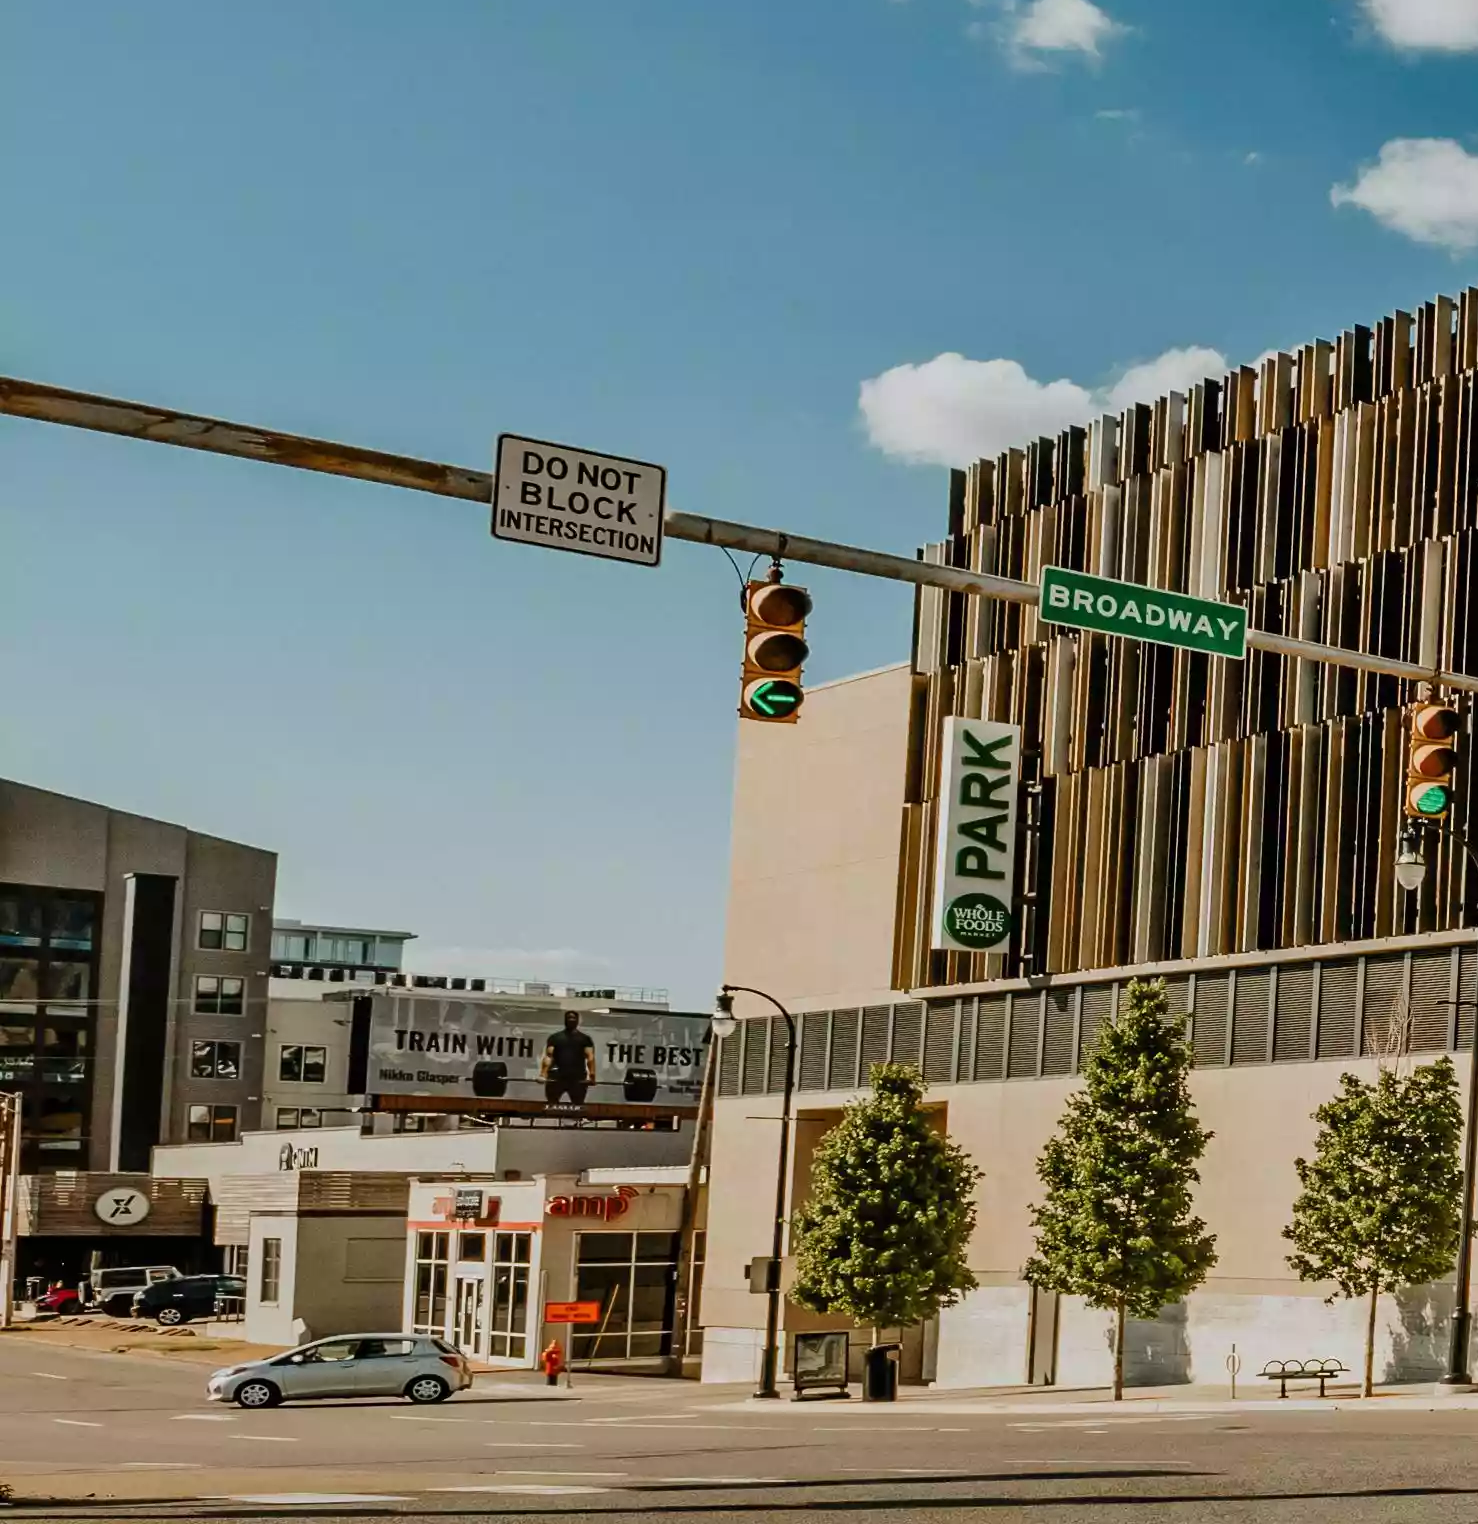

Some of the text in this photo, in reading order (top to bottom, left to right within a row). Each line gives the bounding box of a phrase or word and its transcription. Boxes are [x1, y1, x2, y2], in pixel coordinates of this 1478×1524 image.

[522, 450, 642, 495] DO NOT
[520, 480, 638, 525] BLOCK
[499, 508, 655, 555] INTERSECTION
[1049, 584, 1239, 641] BROADWAY
[956, 728, 1013, 881] PARK
[952, 903, 1005, 922] WHOLE
[955, 918, 1004, 933] FOODS
[394, 1029, 704, 1067] TRAIN WITH THE BEST
[545, 1194, 629, 1222] amp
